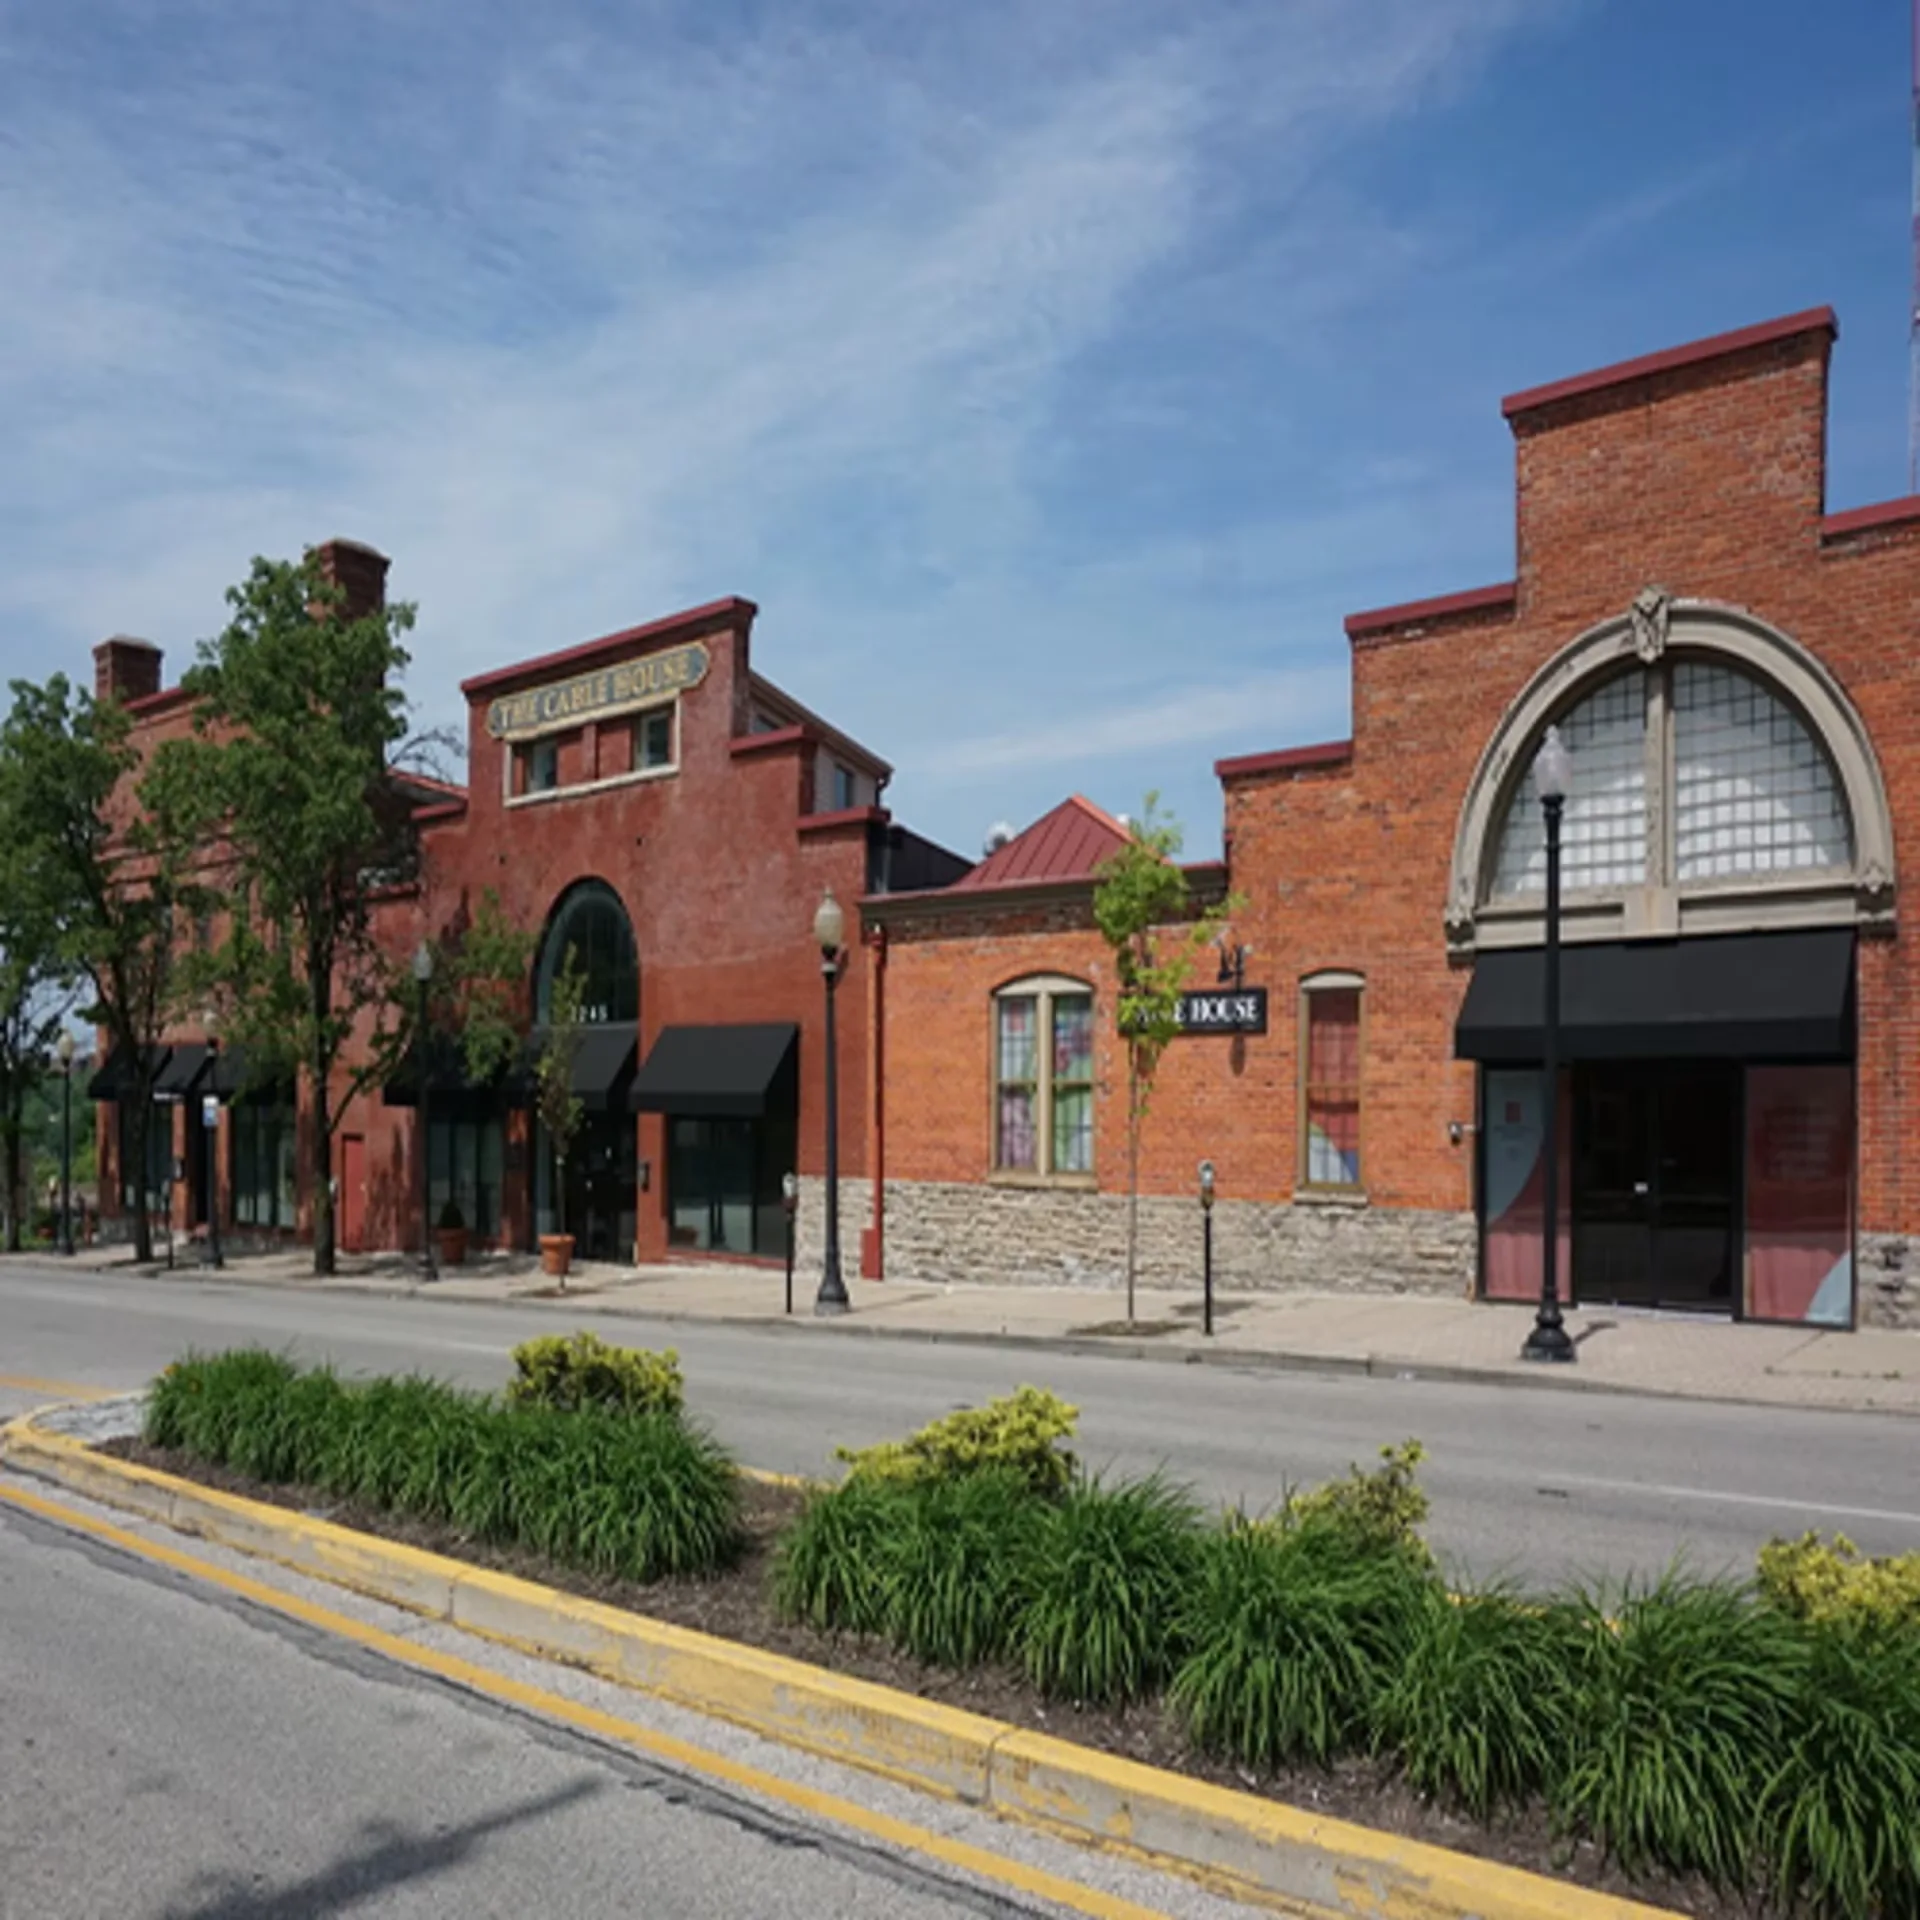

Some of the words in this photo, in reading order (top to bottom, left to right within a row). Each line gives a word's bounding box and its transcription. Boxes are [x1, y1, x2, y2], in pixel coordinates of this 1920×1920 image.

[499, 698, 538, 728] THE
[543, 677, 608, 716] CABLE
[613, 652, 690, 698] HOUSE
[1190, 995, 1257, 1023] HOUSE
